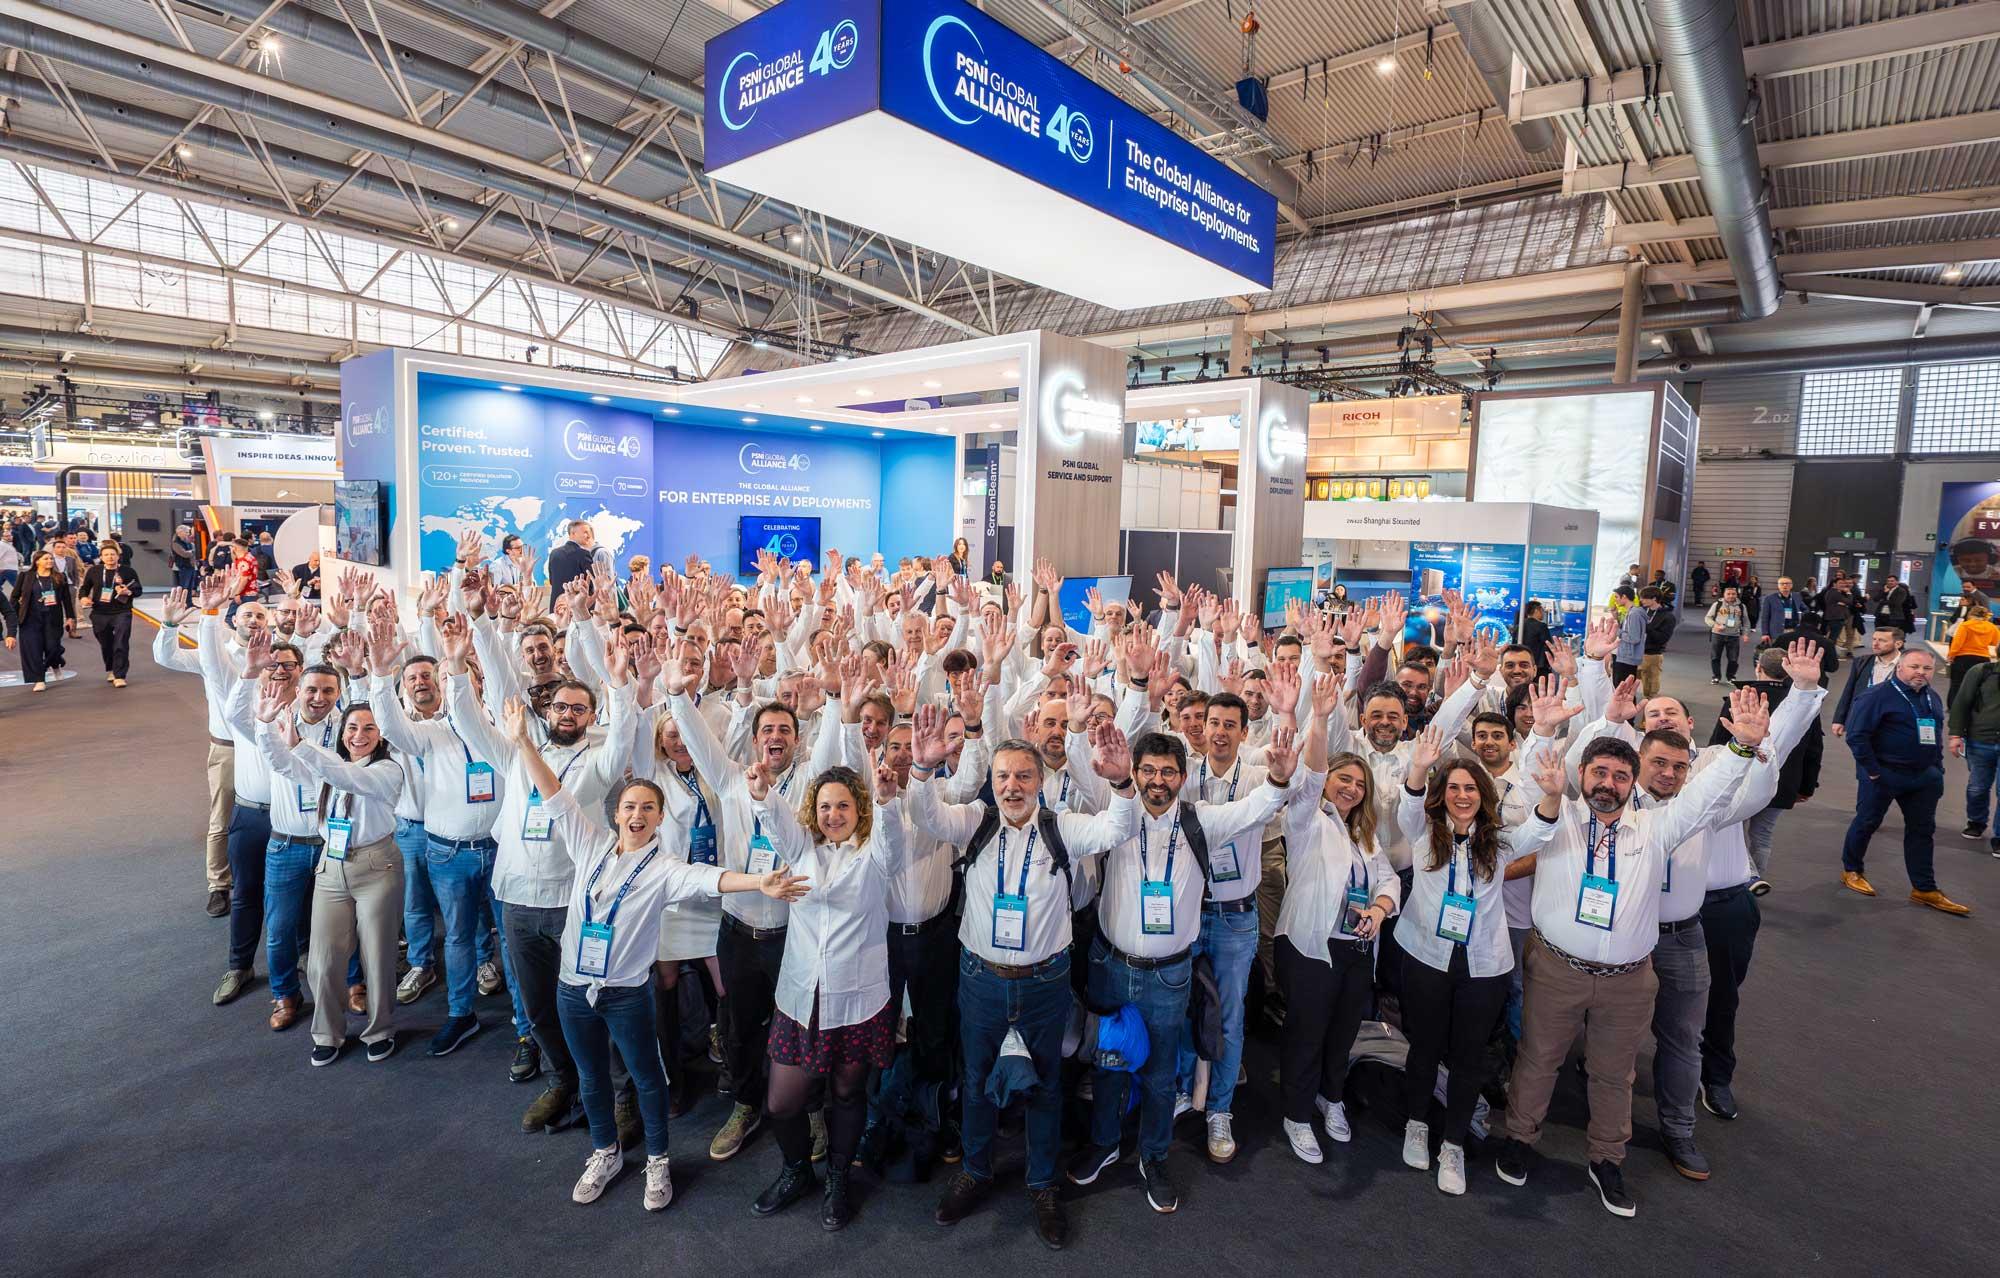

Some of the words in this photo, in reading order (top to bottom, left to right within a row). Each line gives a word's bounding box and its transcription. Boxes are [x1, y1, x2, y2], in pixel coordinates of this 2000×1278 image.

[833, 38, 854, 53] YEARS
[762, 50, 804, 80] GLOBAL
[738, 66, 804, 111] ALLIANCE
[990, 72, 1041, 115] GLOBAL
[954, 76, 1041, 138] ALLIANCE
[1070, 130, 1090, 147] YEARS
[1126, 139, 1152, 170] The
[1153, 156, 1192, 193] Global
[1193, 179, 1235, 217] Alliance
[1236, 202, 1251, 225] for
[1125, 167, 1189, 216] Enterprise
[1191, 201, 1260, 253] Deployments.
[1343, 412, 1380, 421] RICOH
[421, 424, 488, 440] Certified.
[593, 434, 616, 444] GLOBAL
[238, 451, 273, 459] INSPIRE
[422, 440, 476, 455] Proven.
[480, 444, 533, 458] Trusted.
[577, 441, 617, 455] ALLIANCE
[751, 459, 787, 469] ALLIANCE
[765, 453, 786, 462] GLOBAL
[1077, 461, 1099, 470] GLOBAL
[431, 471, 458, 481] 120+
[560, 478, 578, 488] 250+
[1047, 471, 1073, 481] SERVICE
[1073, 473, 1087, 482] AND
[1087, 475, 1112, 483] SUPPORT
[617, 482, 627, 491] 70
[753, 483, 779, 491] GLOBAL
[659, 490, 688, 504] FOR
[692, 491, 770, 506] ENTERPRISE
[773, 495, 790, 507] AV
[793, 496, 872, 509] DEPLOYMENTS
[987, 463, 998, 537] ScreenBeam
[1363, 516, 1391, 526] Shanghai
